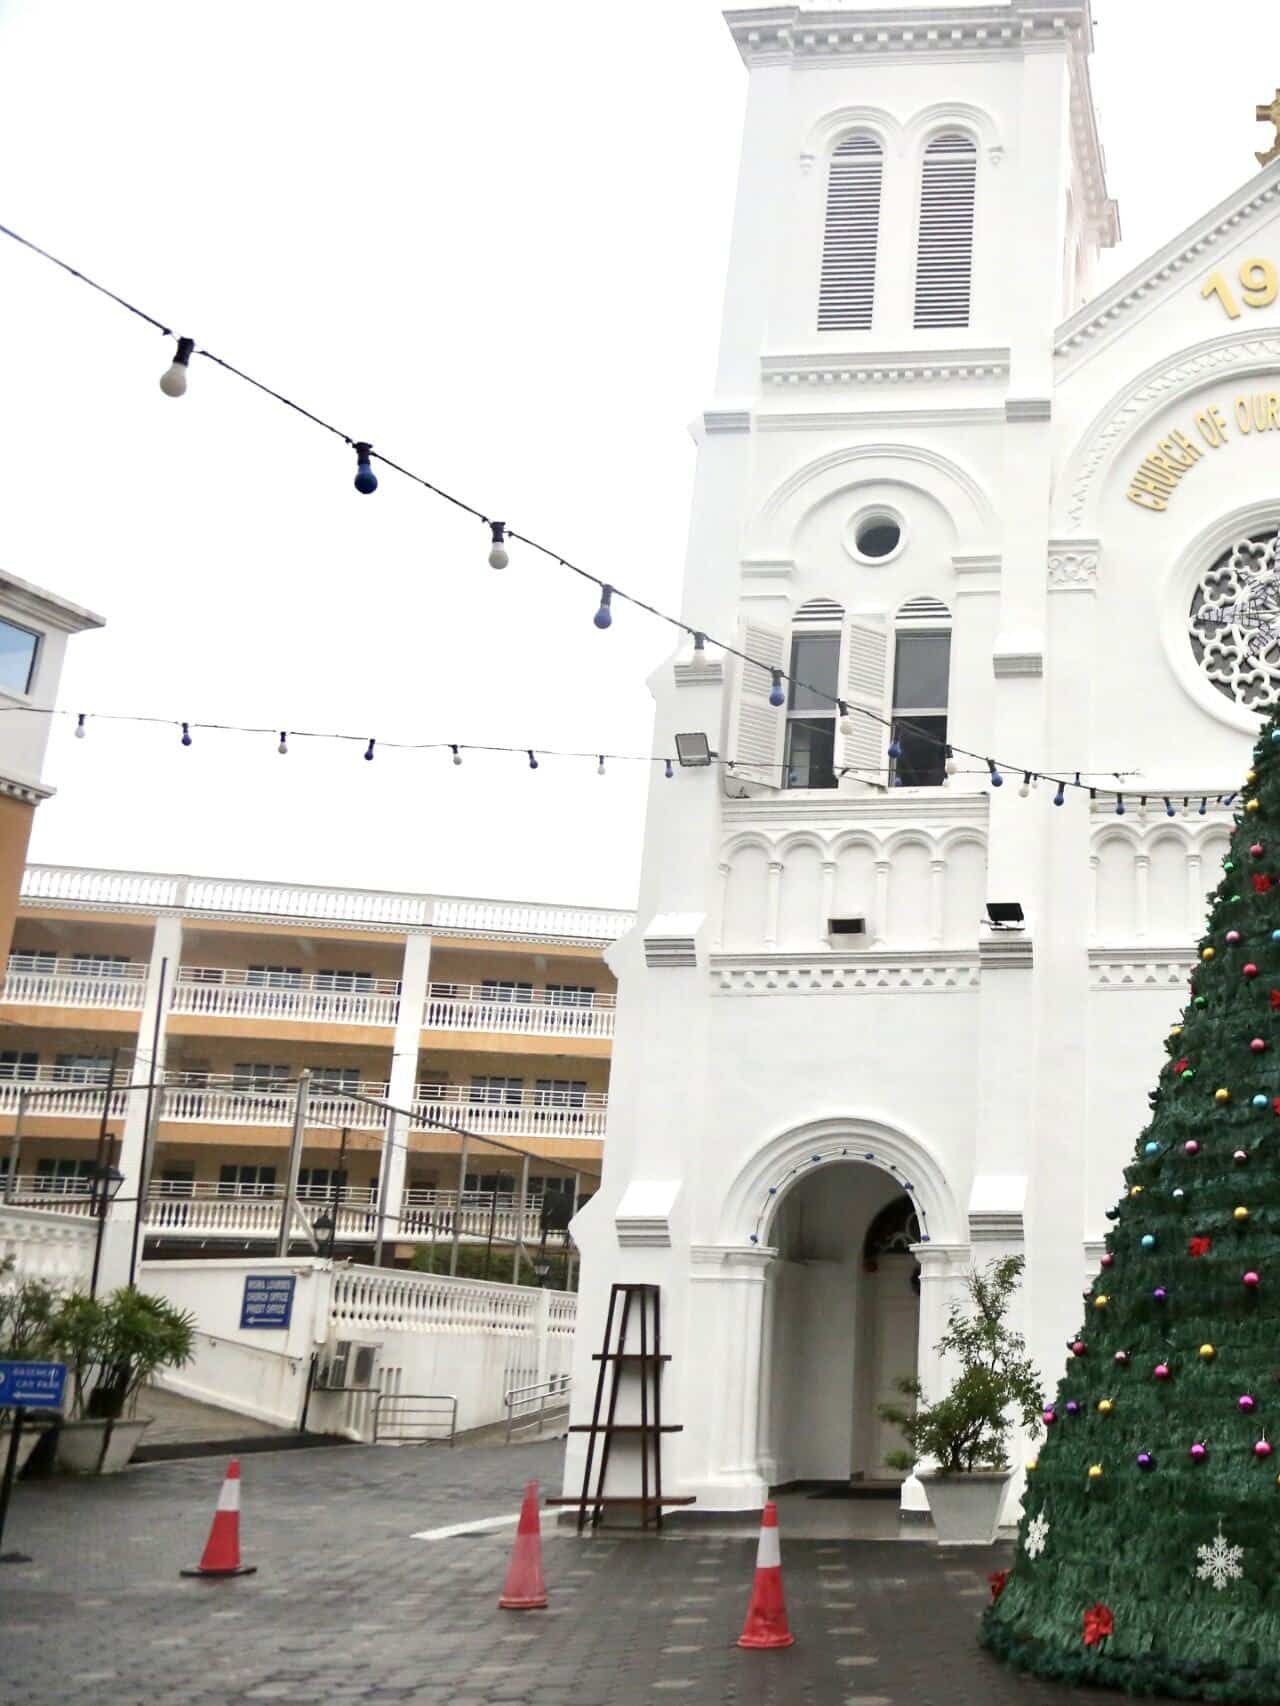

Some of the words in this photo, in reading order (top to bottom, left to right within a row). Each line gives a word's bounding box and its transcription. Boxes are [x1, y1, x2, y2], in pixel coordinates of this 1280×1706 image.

[1126, 429, 1204, 512] CHURCH
[1194, 404, 1229, 448] OF
[1234, 392, 1280, 435] OUR
